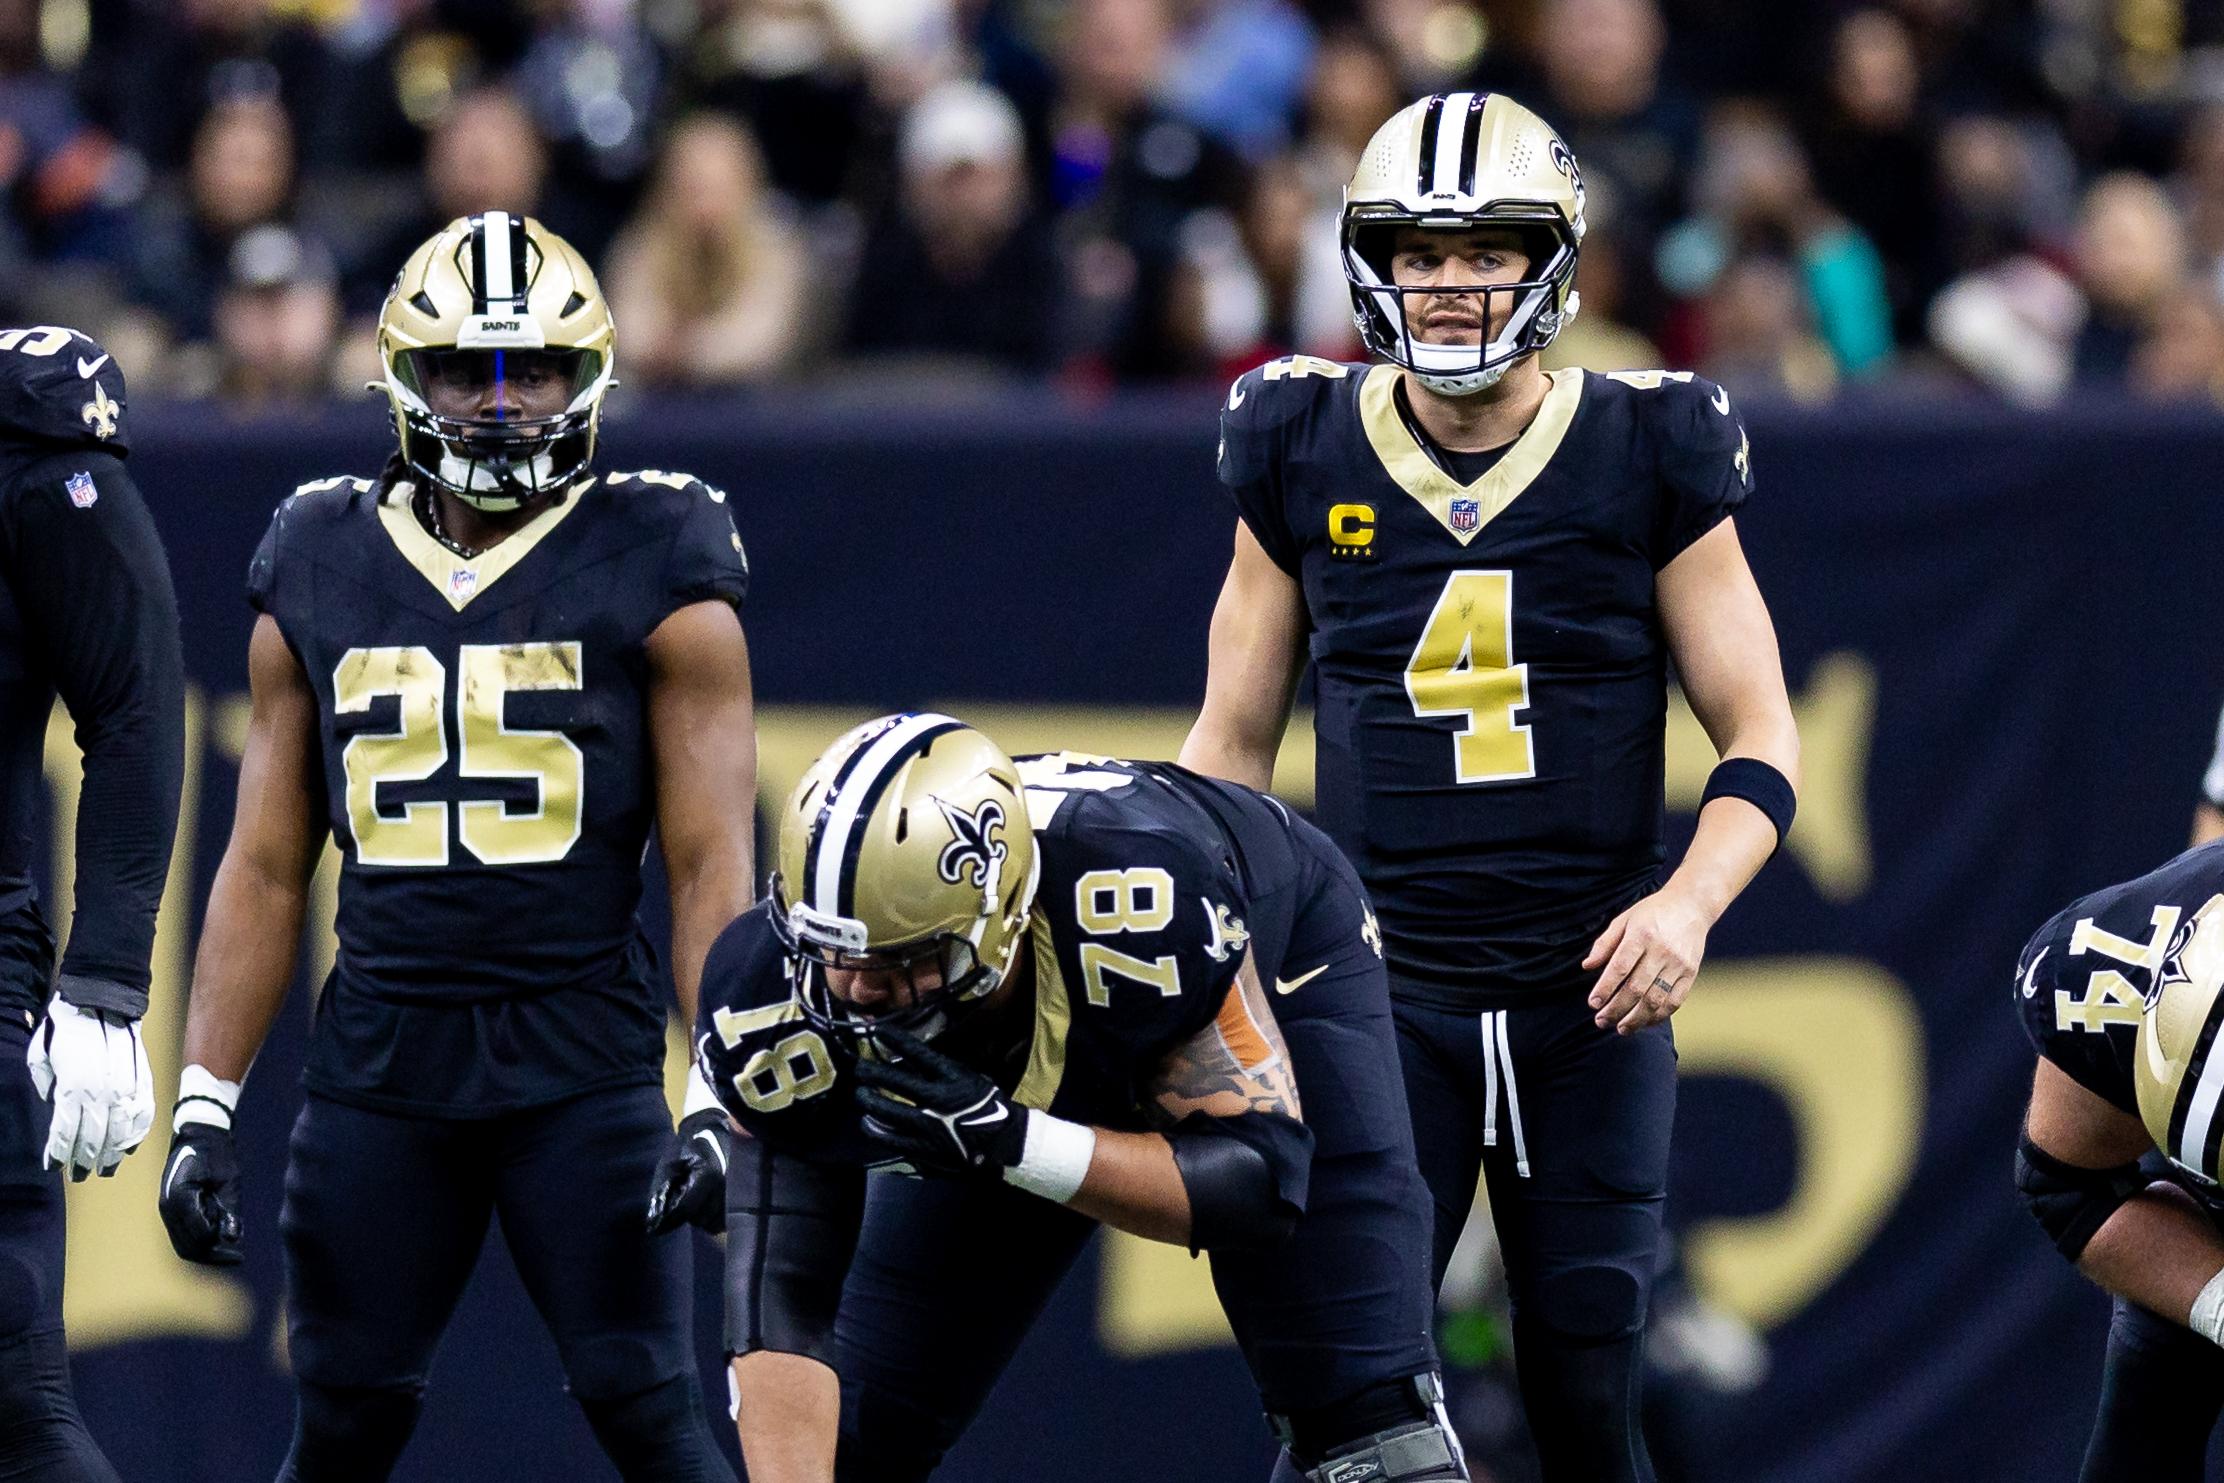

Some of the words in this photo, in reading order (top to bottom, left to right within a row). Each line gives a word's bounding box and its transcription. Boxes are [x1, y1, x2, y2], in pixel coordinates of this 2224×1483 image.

[481, 321, 520, 331] SAINTS
[1328, 503, 1375, 546] C
[1453, 512, 1476, 527] NFL
[1404, 569, 1536, 784] 4
[333, 641, 584, 867] 25
[1075, 867, 1182, 1008] 78
[2054, 904, 2182, 1033] 74
